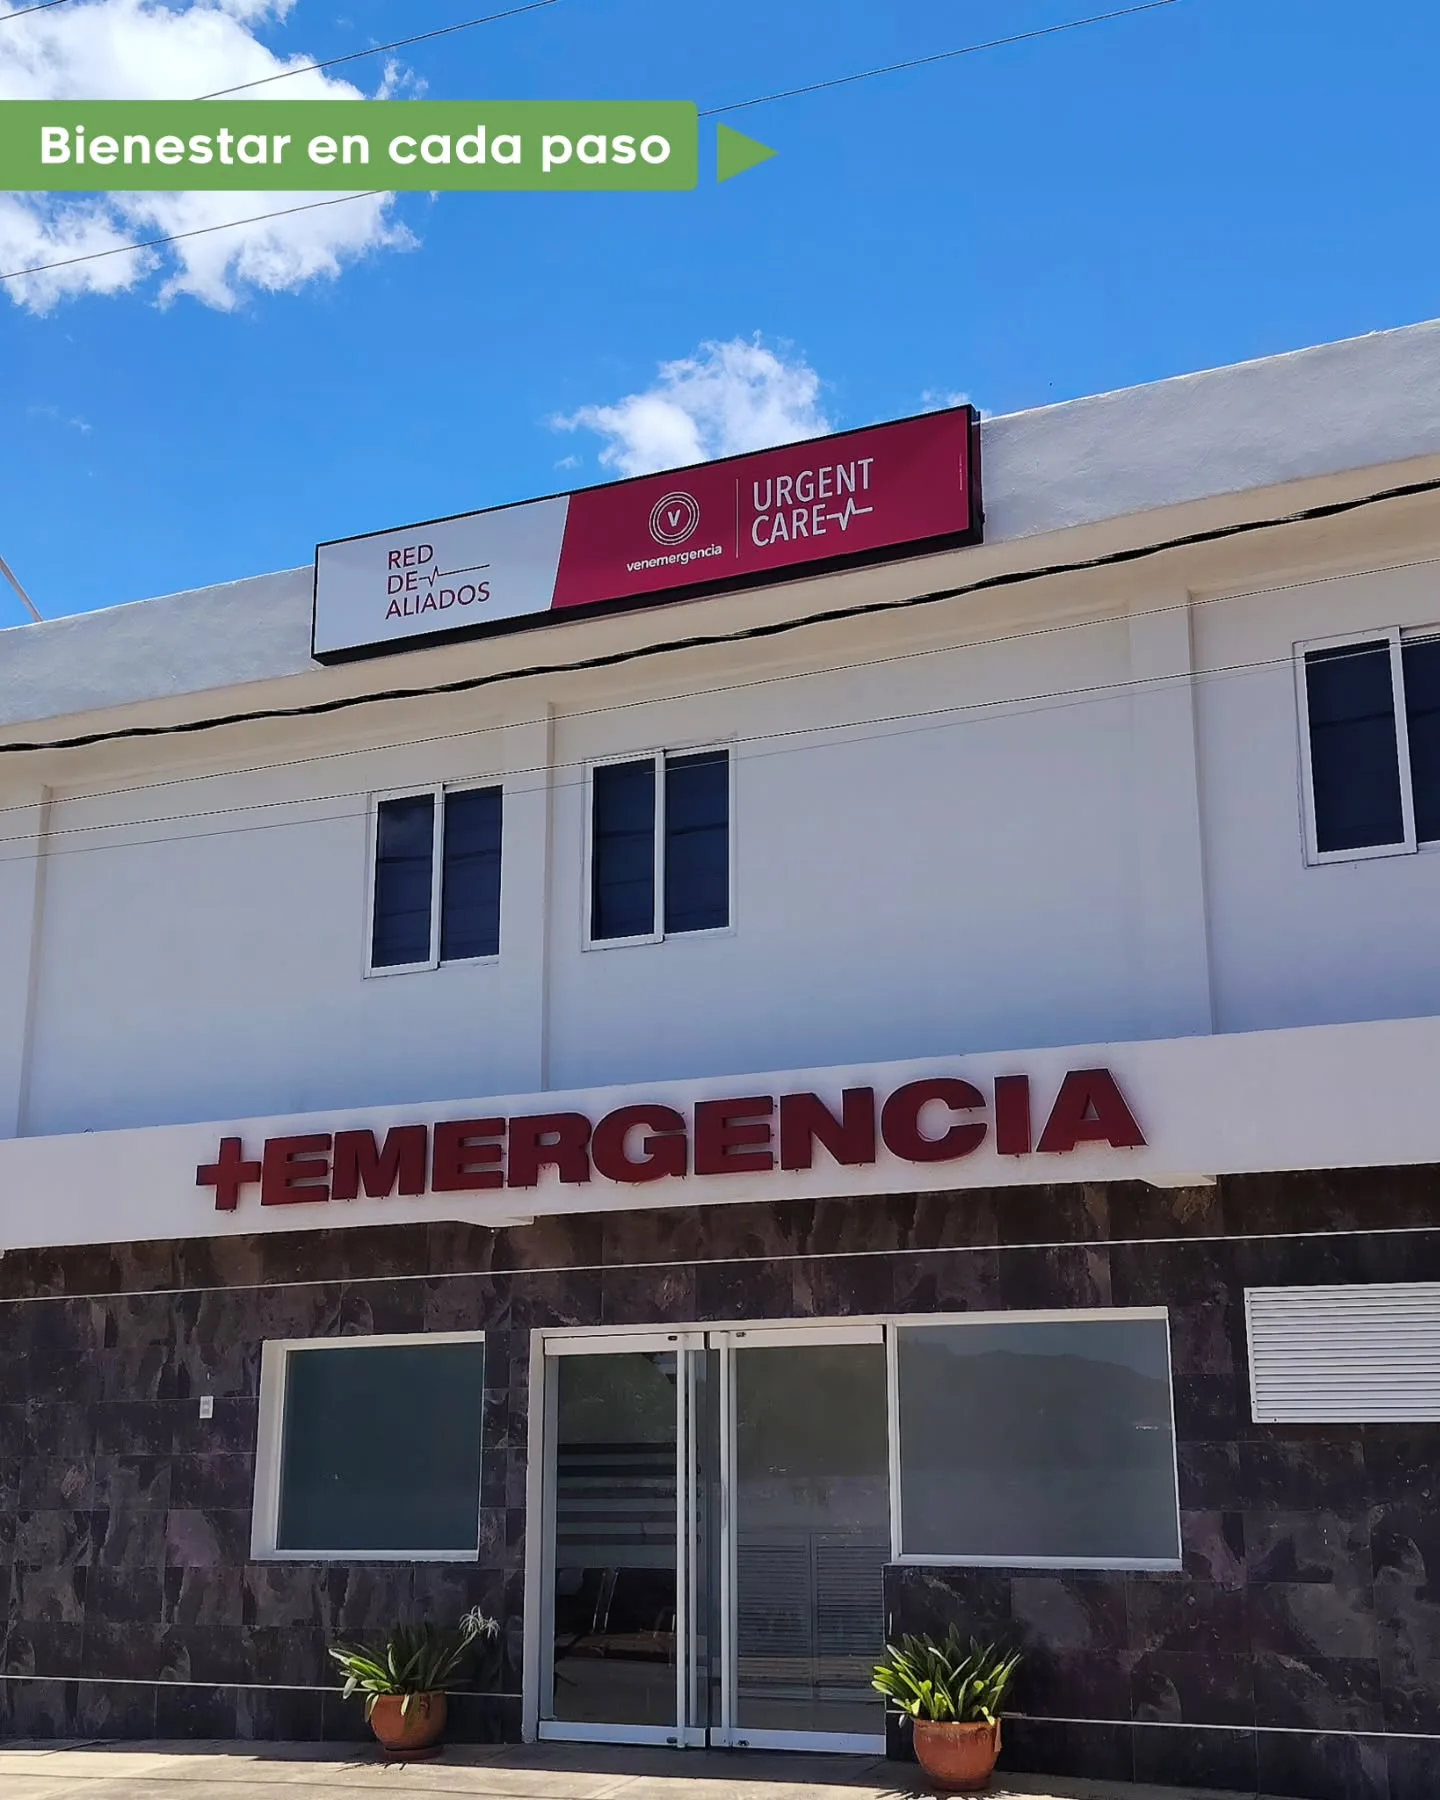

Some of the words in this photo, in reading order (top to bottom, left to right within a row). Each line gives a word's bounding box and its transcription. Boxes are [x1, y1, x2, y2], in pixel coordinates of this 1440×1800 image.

[753, 457, 875, 512] URGENT
[751, 503, 827, 547] CARE
[387, 544, 434, 571] RED
[626, 543, 723, 572] venemergencia
[387, 570, 418, 595] DE
[385, 581, 491, 620] ALIADOS
